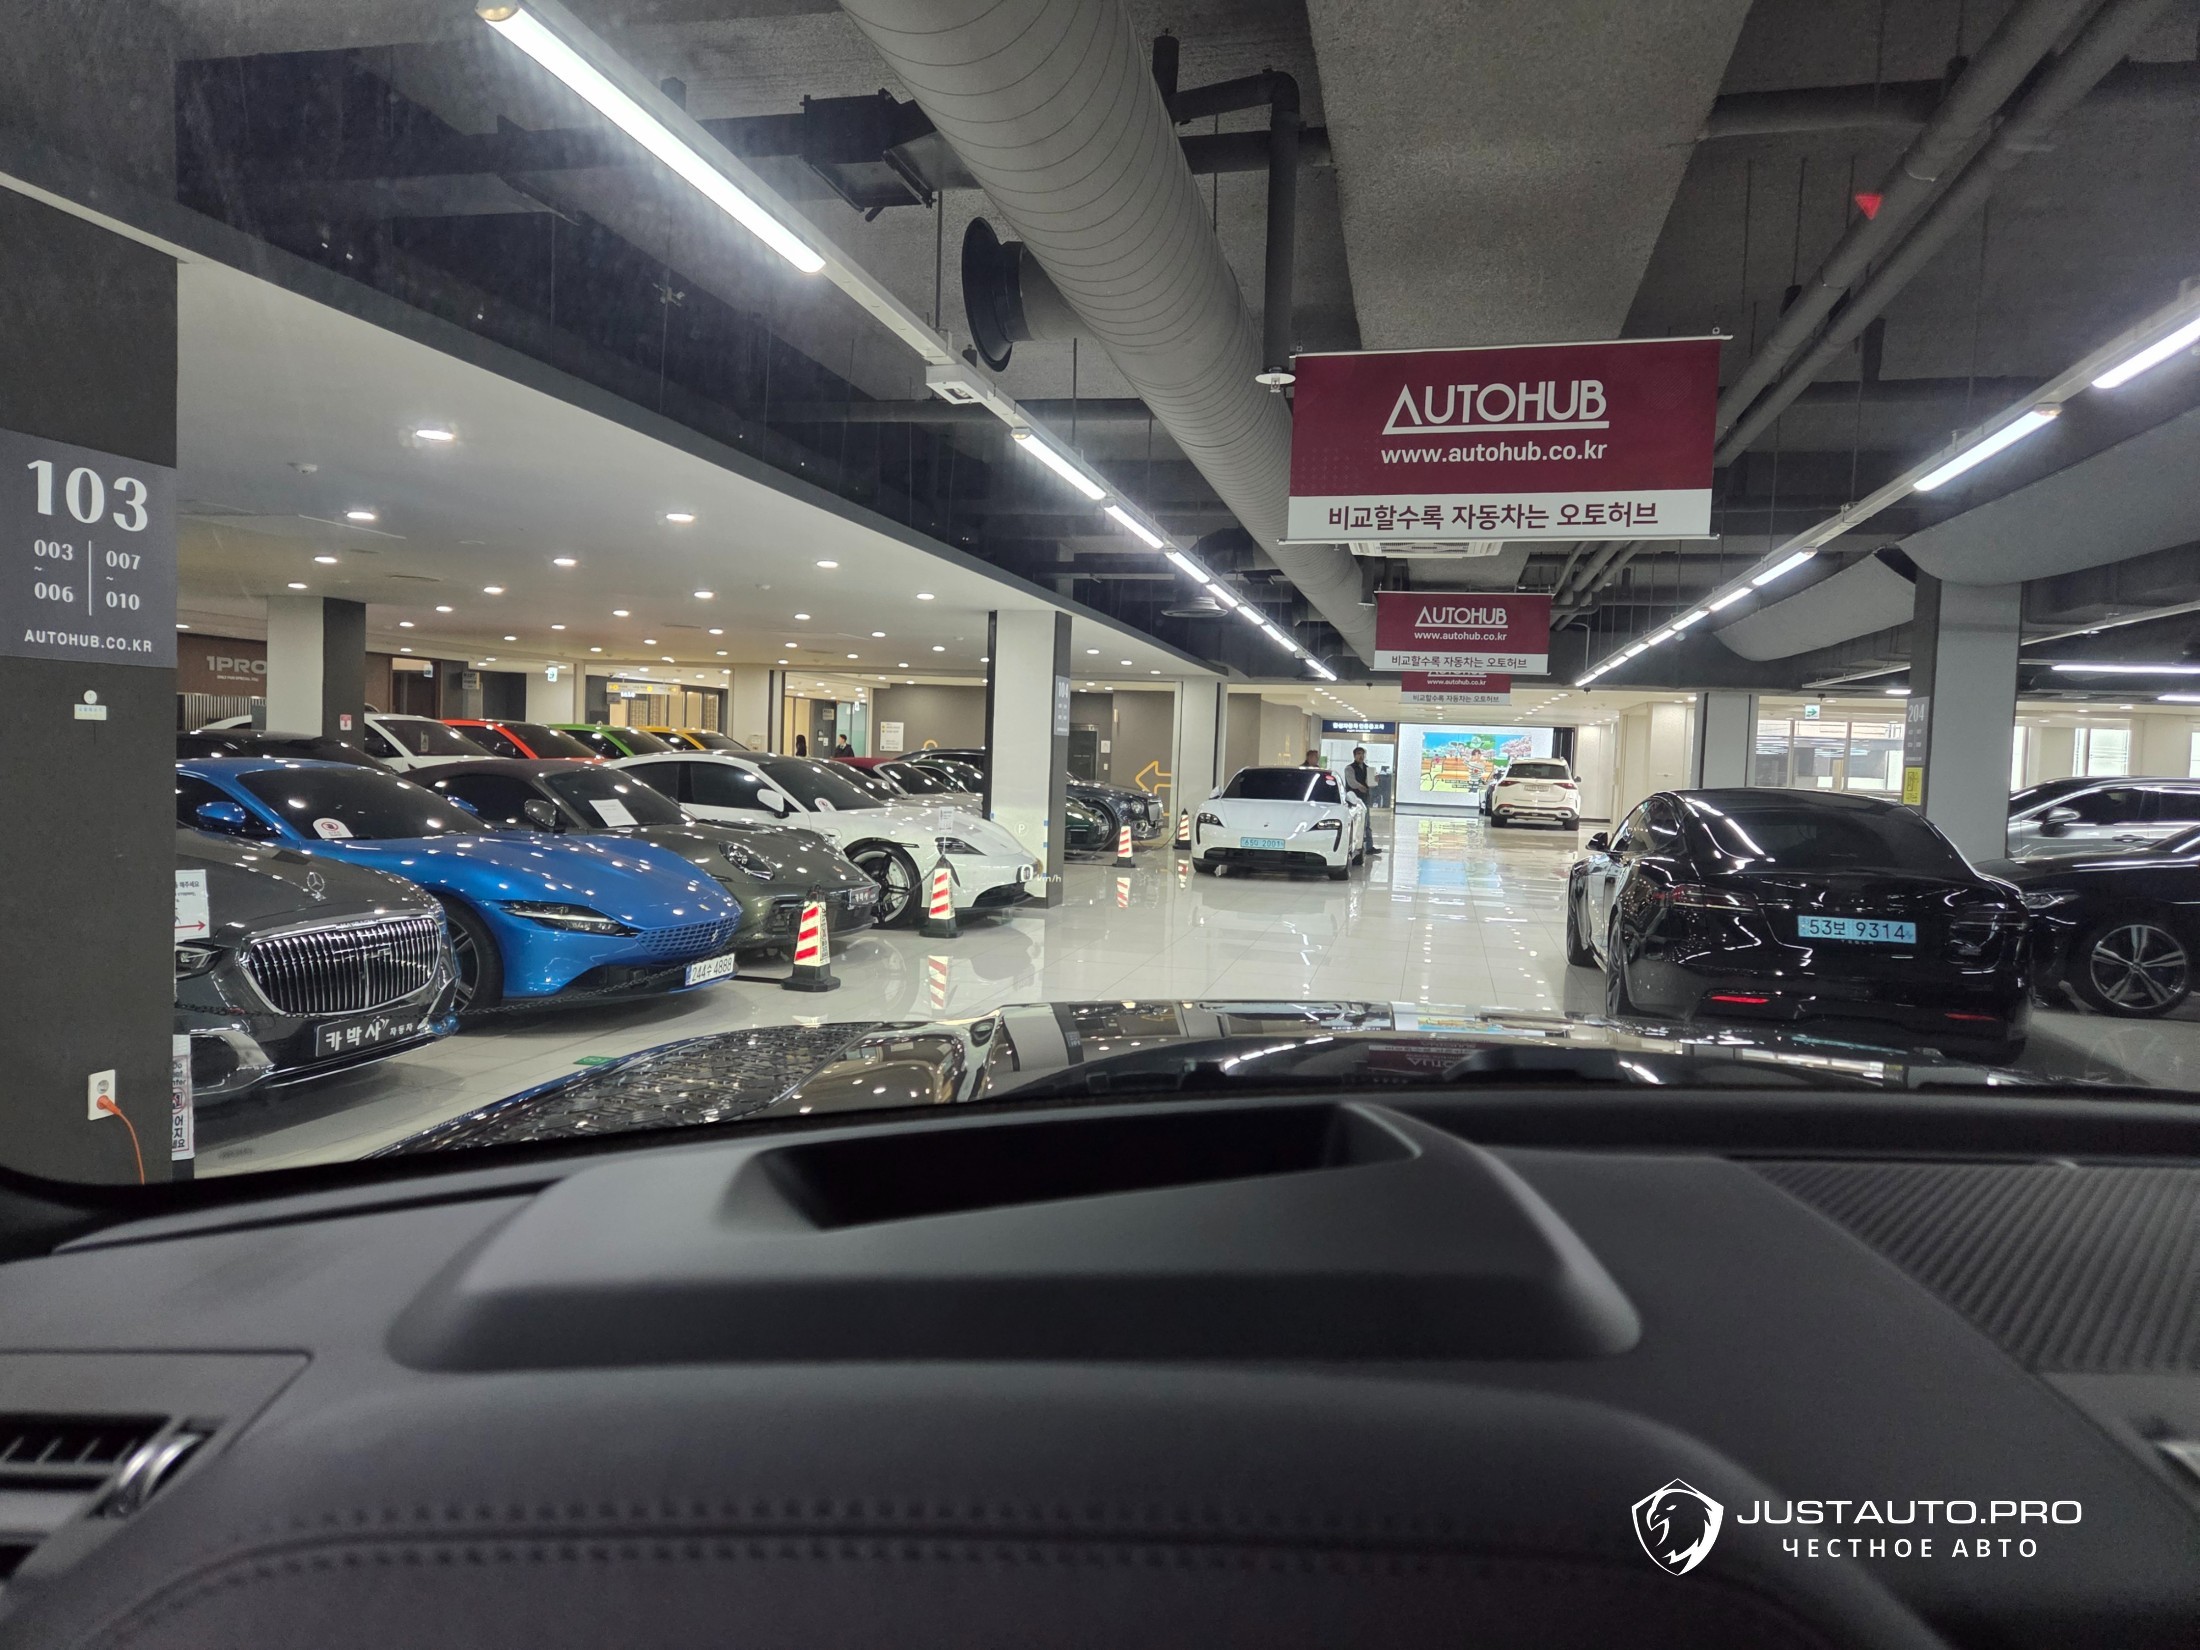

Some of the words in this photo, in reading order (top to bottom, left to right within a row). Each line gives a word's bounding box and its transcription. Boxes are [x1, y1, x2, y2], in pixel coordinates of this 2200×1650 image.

[1382, 379, 1609, 434] AUTOHUB
[1382, 440, 1607, 464] www.autohub.co.kr
[27, 459, 148, 532] 103
[1329, 504, 1444, 531] 비교할수록
[1451, 503, 1549, 529] 자동차는
[1557, 501, 1659, 527] 오토허브
[34, 539, 74, 561] 003
[106, 550, 141, 570] 007
[34, 582, 74, 603] 006
[106, 591, 140, 610] 010
[1415, 606, 1508, 628] AUTOHUB
[24, 629, 153, 653] AUTOHUB.CO.KR
[1414, 632, 1507, 641] www.autohub.co.kr
[206, 655, 267, 674] 1PRO
[1392, 655, 1441, 667] 비교할수록
[1443, 657, 1484, 668] 자동차는
[1486, 658, 1527, 669] 오토허브
[1413, 695, 1444, 703] 비교할수록
[1446, 695, 1472, 703] 자동차는
[1474, 695, 1500, 703] 오토허브
[1908, 703, 1925, 723] 204
[1020, 864, 1034, 882] 0
[1809, 919, 1845, 936] 53보
[1856, 922, 1905, 940] 9314
[692, 964, 712, 981] 244수
[714, 958, 732, 974] 4888
[172, 1079, 187, 1087] nter
[173, 1070, 183, 1078] ot
[174, 1115, 184, 1126] 어
[173, 1128, 183, 1138] 지
